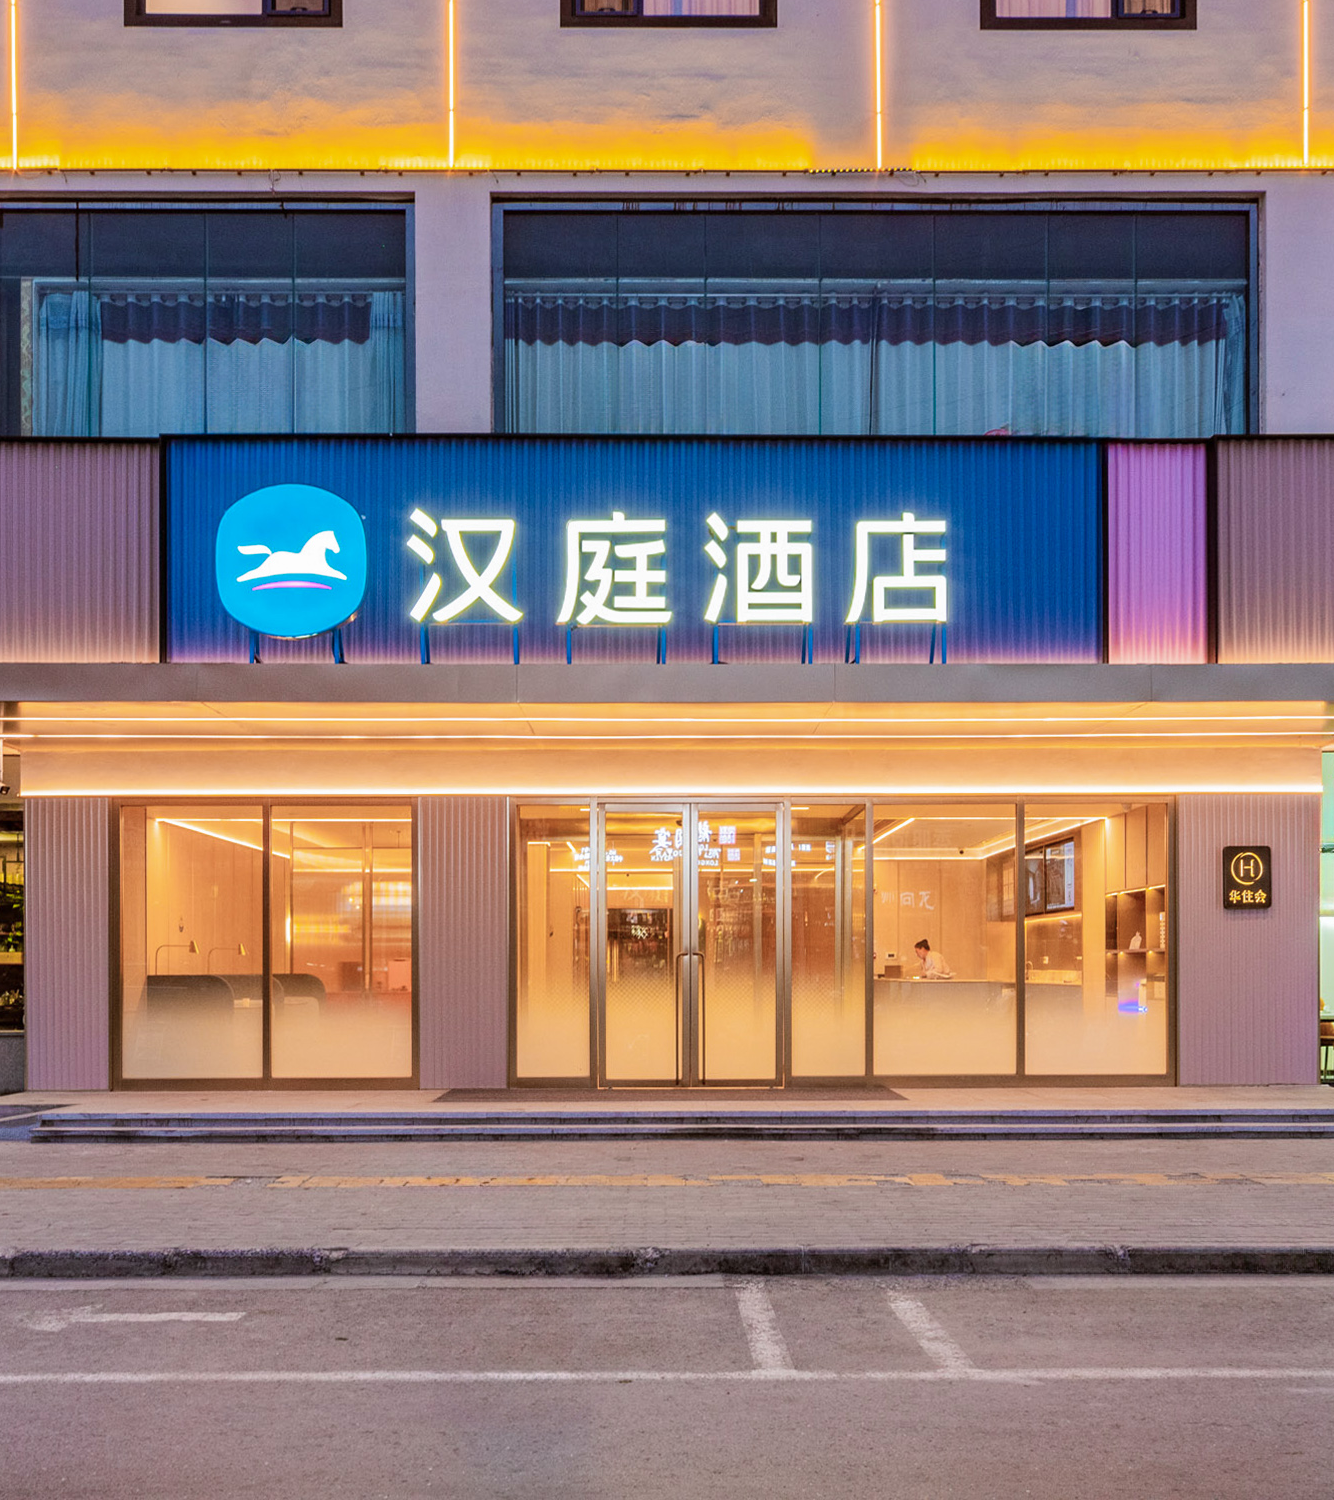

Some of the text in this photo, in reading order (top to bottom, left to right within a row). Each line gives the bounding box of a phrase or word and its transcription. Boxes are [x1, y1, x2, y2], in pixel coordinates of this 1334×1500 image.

[406, 507, 951, 625] 汉庭酒店
[1240, 859, 1255, 877] H
[1229, 889, 1267, 904] 华住会
